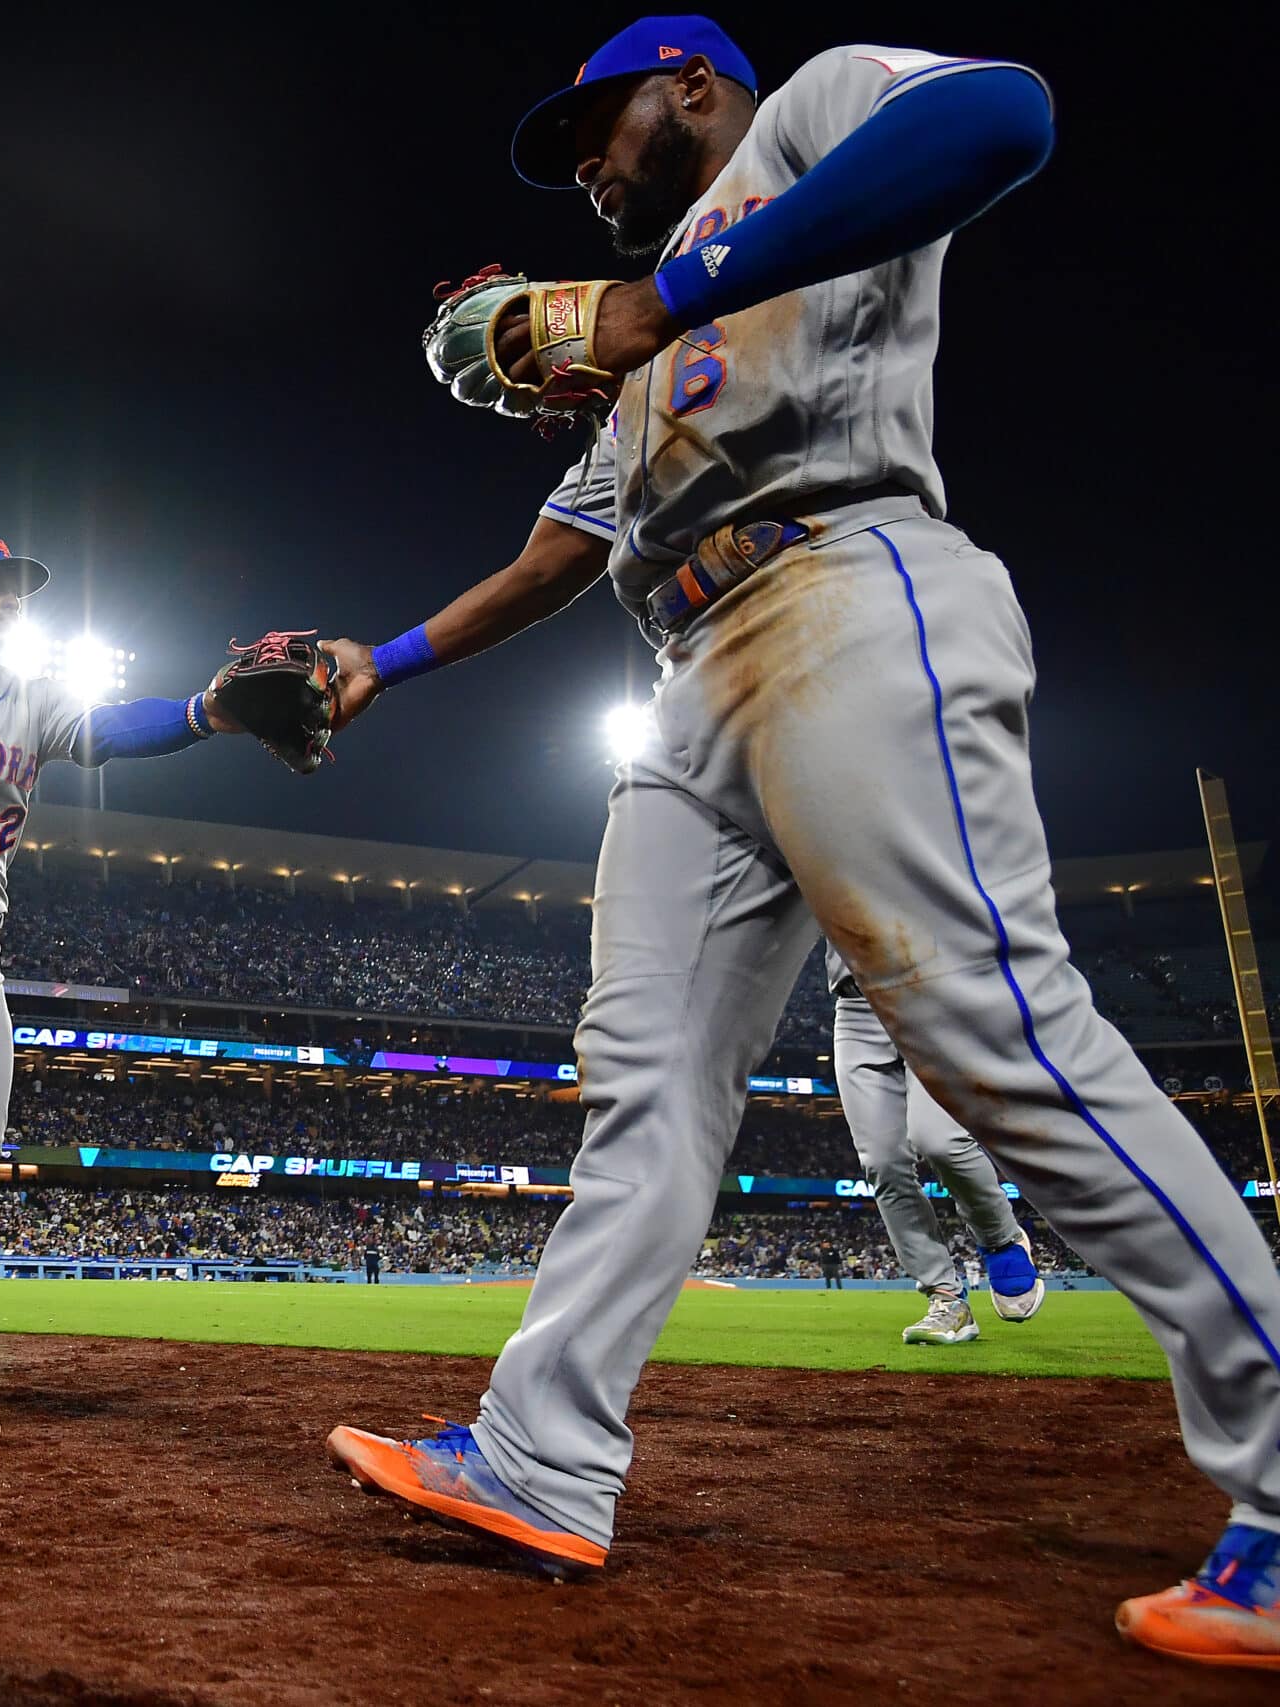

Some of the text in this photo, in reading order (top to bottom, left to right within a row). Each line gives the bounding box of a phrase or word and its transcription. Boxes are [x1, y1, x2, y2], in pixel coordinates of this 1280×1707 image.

[14, 1027, 219, 1056] CAP SHUFFLE
[210, 1154, 274, 1173] CAP
[285, 1157, 420, 1180] SHUFFLE
